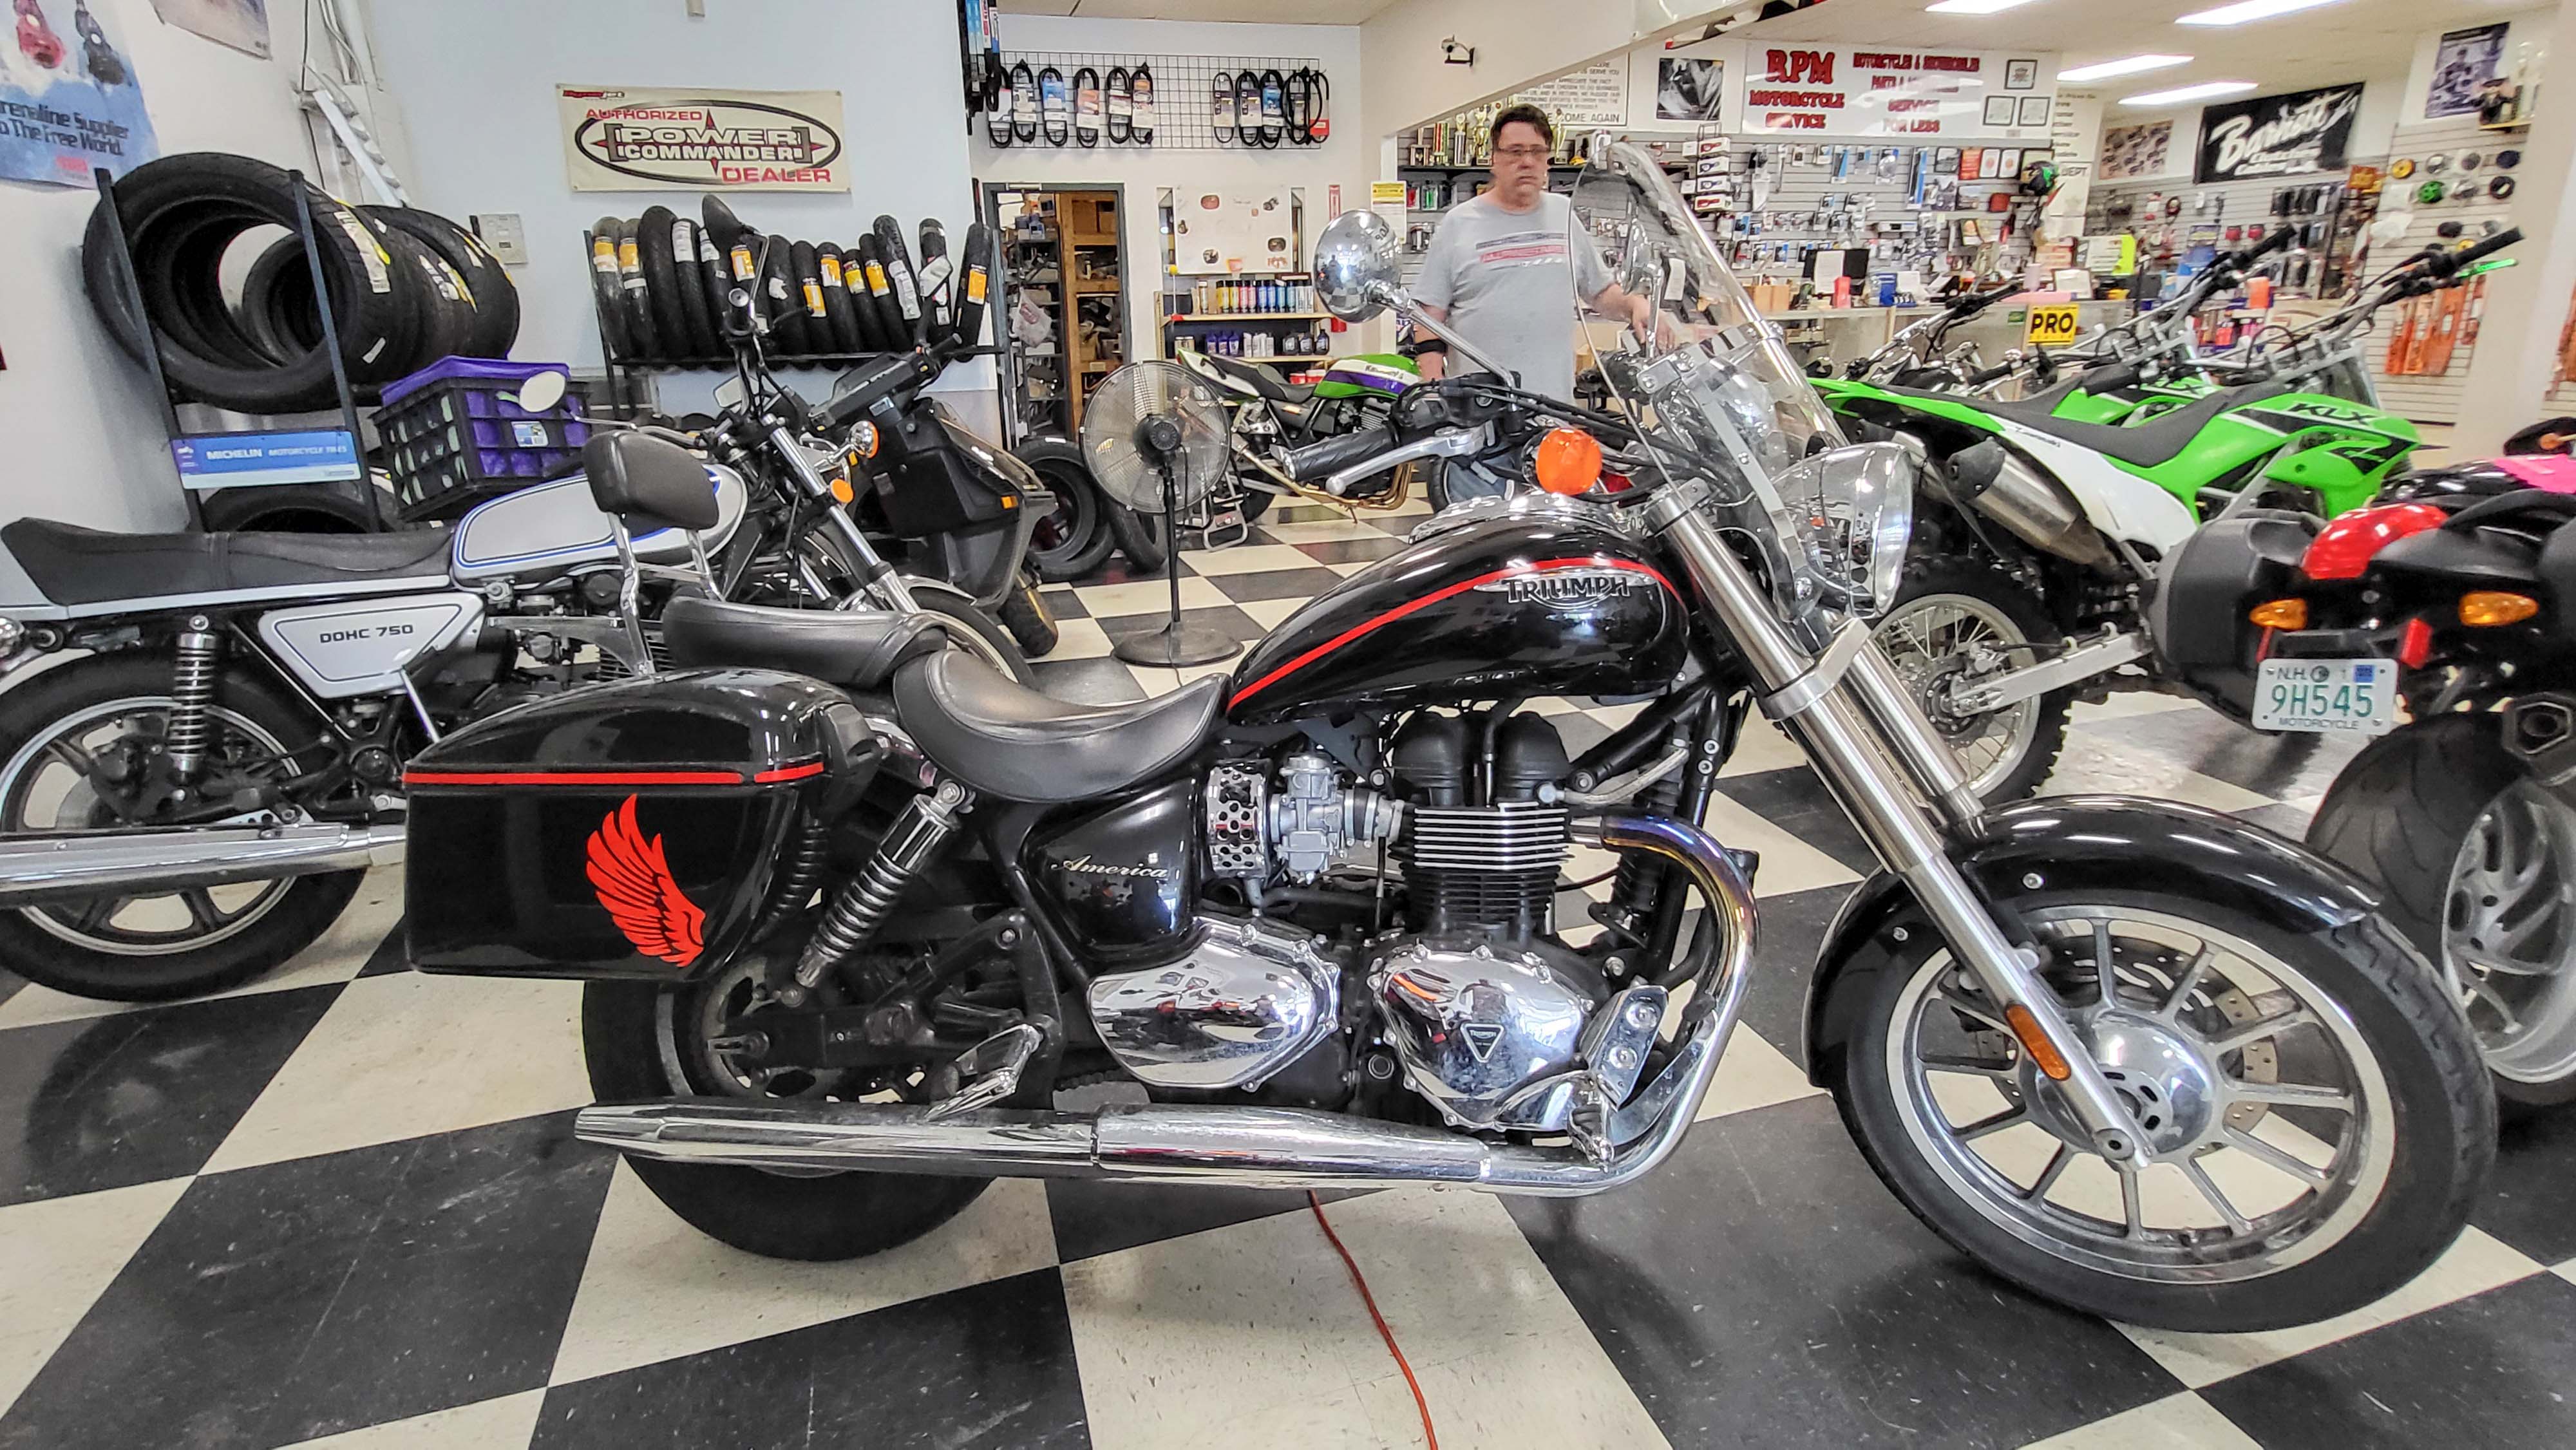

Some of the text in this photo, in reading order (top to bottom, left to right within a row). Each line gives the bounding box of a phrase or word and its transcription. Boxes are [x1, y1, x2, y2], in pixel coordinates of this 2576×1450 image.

[1765, 49, 1835, 84] RPM
[1748, 89, 1845, 109] MOTORCYCLE
[585, 108, 703, 121] AUTHORIZED
[1591, 113, 1620, 123] AGAIN
[622, 128, 800, 146] POWER
[626, 146, 790, 162] COMMANDER
[721, 167, 831, 183] DEALER
[2030, 312, 2073, 334] PRO
[2288, 402, 2378, 424] KLX
[206, 448, 263, 460] MICHELIN
[1502, 577, 1631, 604] TRIUMPH
[319, 625, 413, 643] DOHC 750
[2271, 684, 2374, 717] 9H545
[2278, 717, 2359, 730] MOTORCYCLE
[1050, 854, 1170, 878] America
